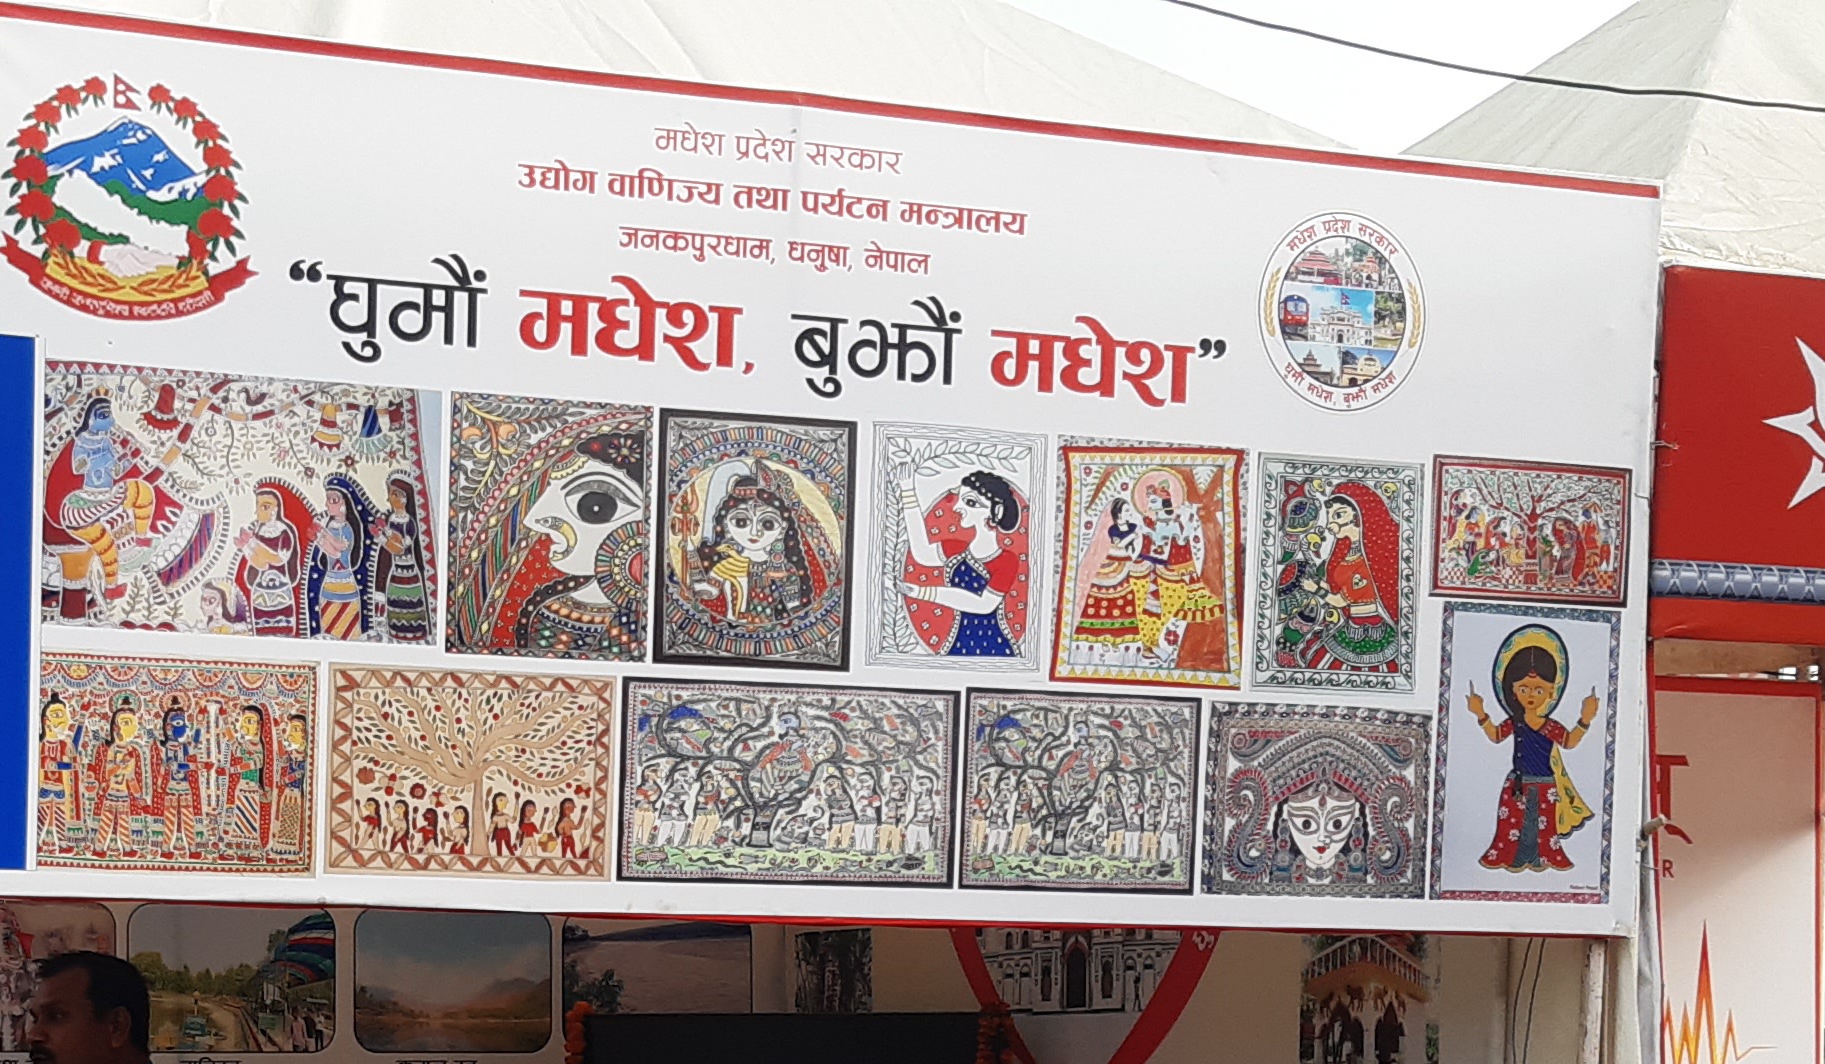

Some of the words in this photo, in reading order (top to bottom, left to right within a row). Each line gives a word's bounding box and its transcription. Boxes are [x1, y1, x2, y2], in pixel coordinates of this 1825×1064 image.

[654, 121, 726, 156] मधेश
[735, 128, 795, 163] प्रदेश
[804, 141, 903, 175] सरकार
[517, 159, 599, 194] उद्योग
[606, 167, 724, 206] वाणिज्य
[732, 183, 792, 212] तथा
[800, 187, 891, 222] पर्यटन
[899, 200, 1028, 236] मन्त्रालय
[618, 226, 776, 265] जनकपुरधाम,
[787, 240, 853, 273] धनुषा,
[864, 240, 932, 275] नेपाल
[1285, 224, 1318, 253] मधेश
[1358, 222, 1400, 260] सरकार
[519, 275, 756, 374] मधेश,
[790, 295, 963, 399] बुझौं
